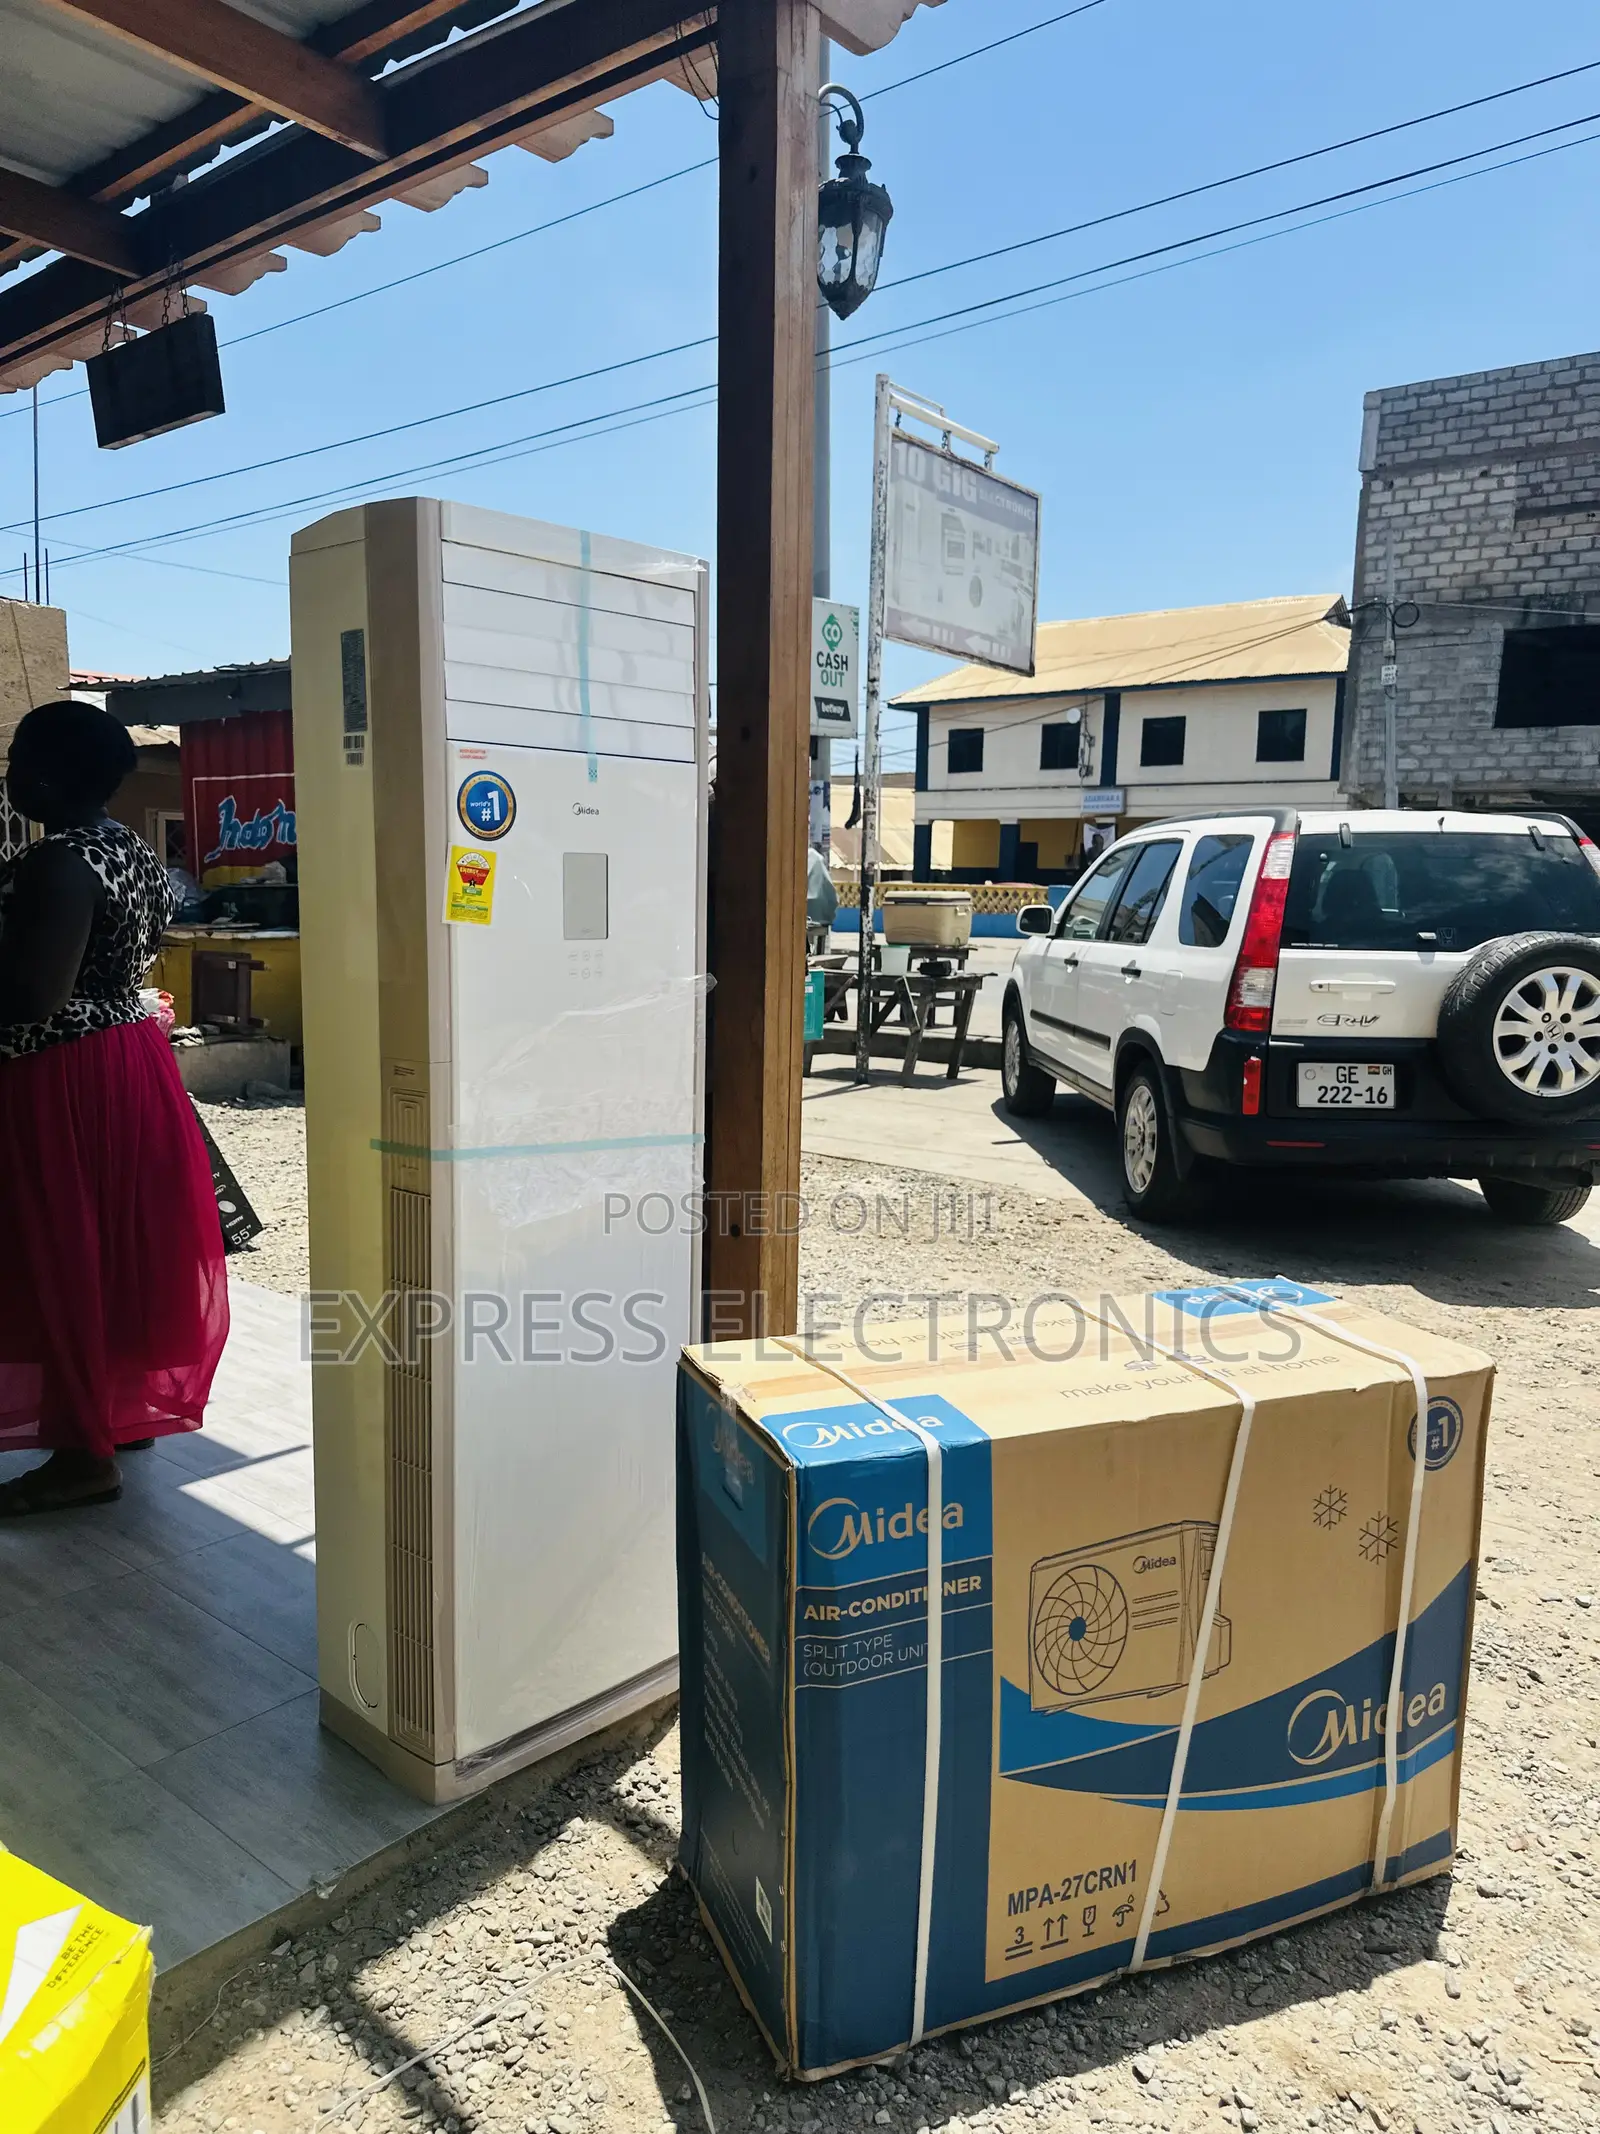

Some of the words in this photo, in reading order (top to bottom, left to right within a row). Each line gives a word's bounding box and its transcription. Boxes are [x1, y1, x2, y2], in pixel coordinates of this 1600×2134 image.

[894, 441, 926, 483] 10
[816, 651, 849, 671] CASH
[820, 669, 845, 688] OUT
[821, 702, 845, 717] betway
[481, 790, 501, 822] #1
[572, 802, 600, 816] Midea
[1336, 1066, 1359, 1084] GE
[1317, 1085, 1388, 1104] 222-16
[1059, 1376, 1133, 1399] make
[1136, 1367, 1236, 1390] yourslf
[1242, 1364, 1267, 1377] at
[1264, 1354, 1340, 1373] home
[1133, 1555, 1176, 1574] Midea
[803, 1575, 982, 1621] AIR-CONDITINER
[803, 1643, 848, 1660] SPLIT
[853, 1633, 893, 1655] TYPE
[803, 1651, 894, 1678] (OUTDOOR
[1007, 1859, 1138, 1917] MPA-27CRN1
[61, 1944, 76, 1961] BE
[75, 1922, 96, 1944] THE
[1014, 1926, 1025, 1945] 3
[46, 1927, 104, 1989] DIFFERENCE
